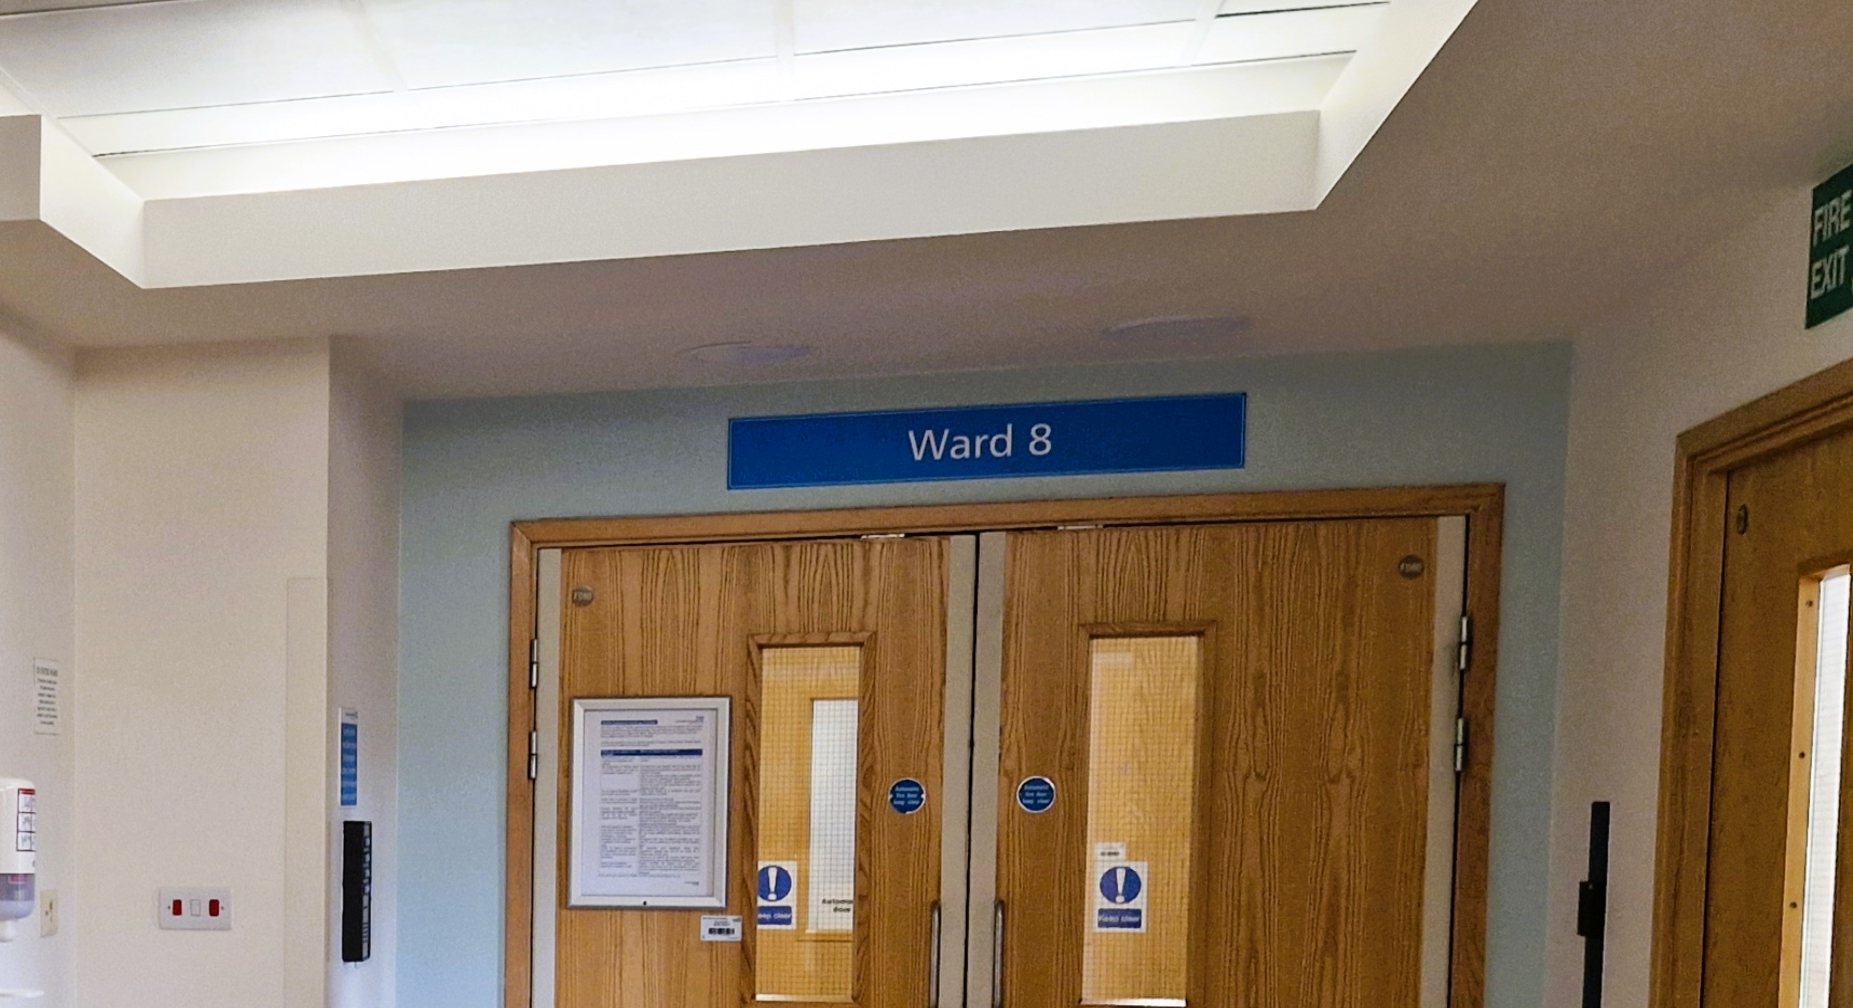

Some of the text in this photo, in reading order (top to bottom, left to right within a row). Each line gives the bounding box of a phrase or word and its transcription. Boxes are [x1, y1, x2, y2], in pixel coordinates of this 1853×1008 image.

[1813, 189, 1852, 247] FIRE
[1810, 245, 1849, 300] EXIT
[908, 423, 1053, 462] Ward 8
